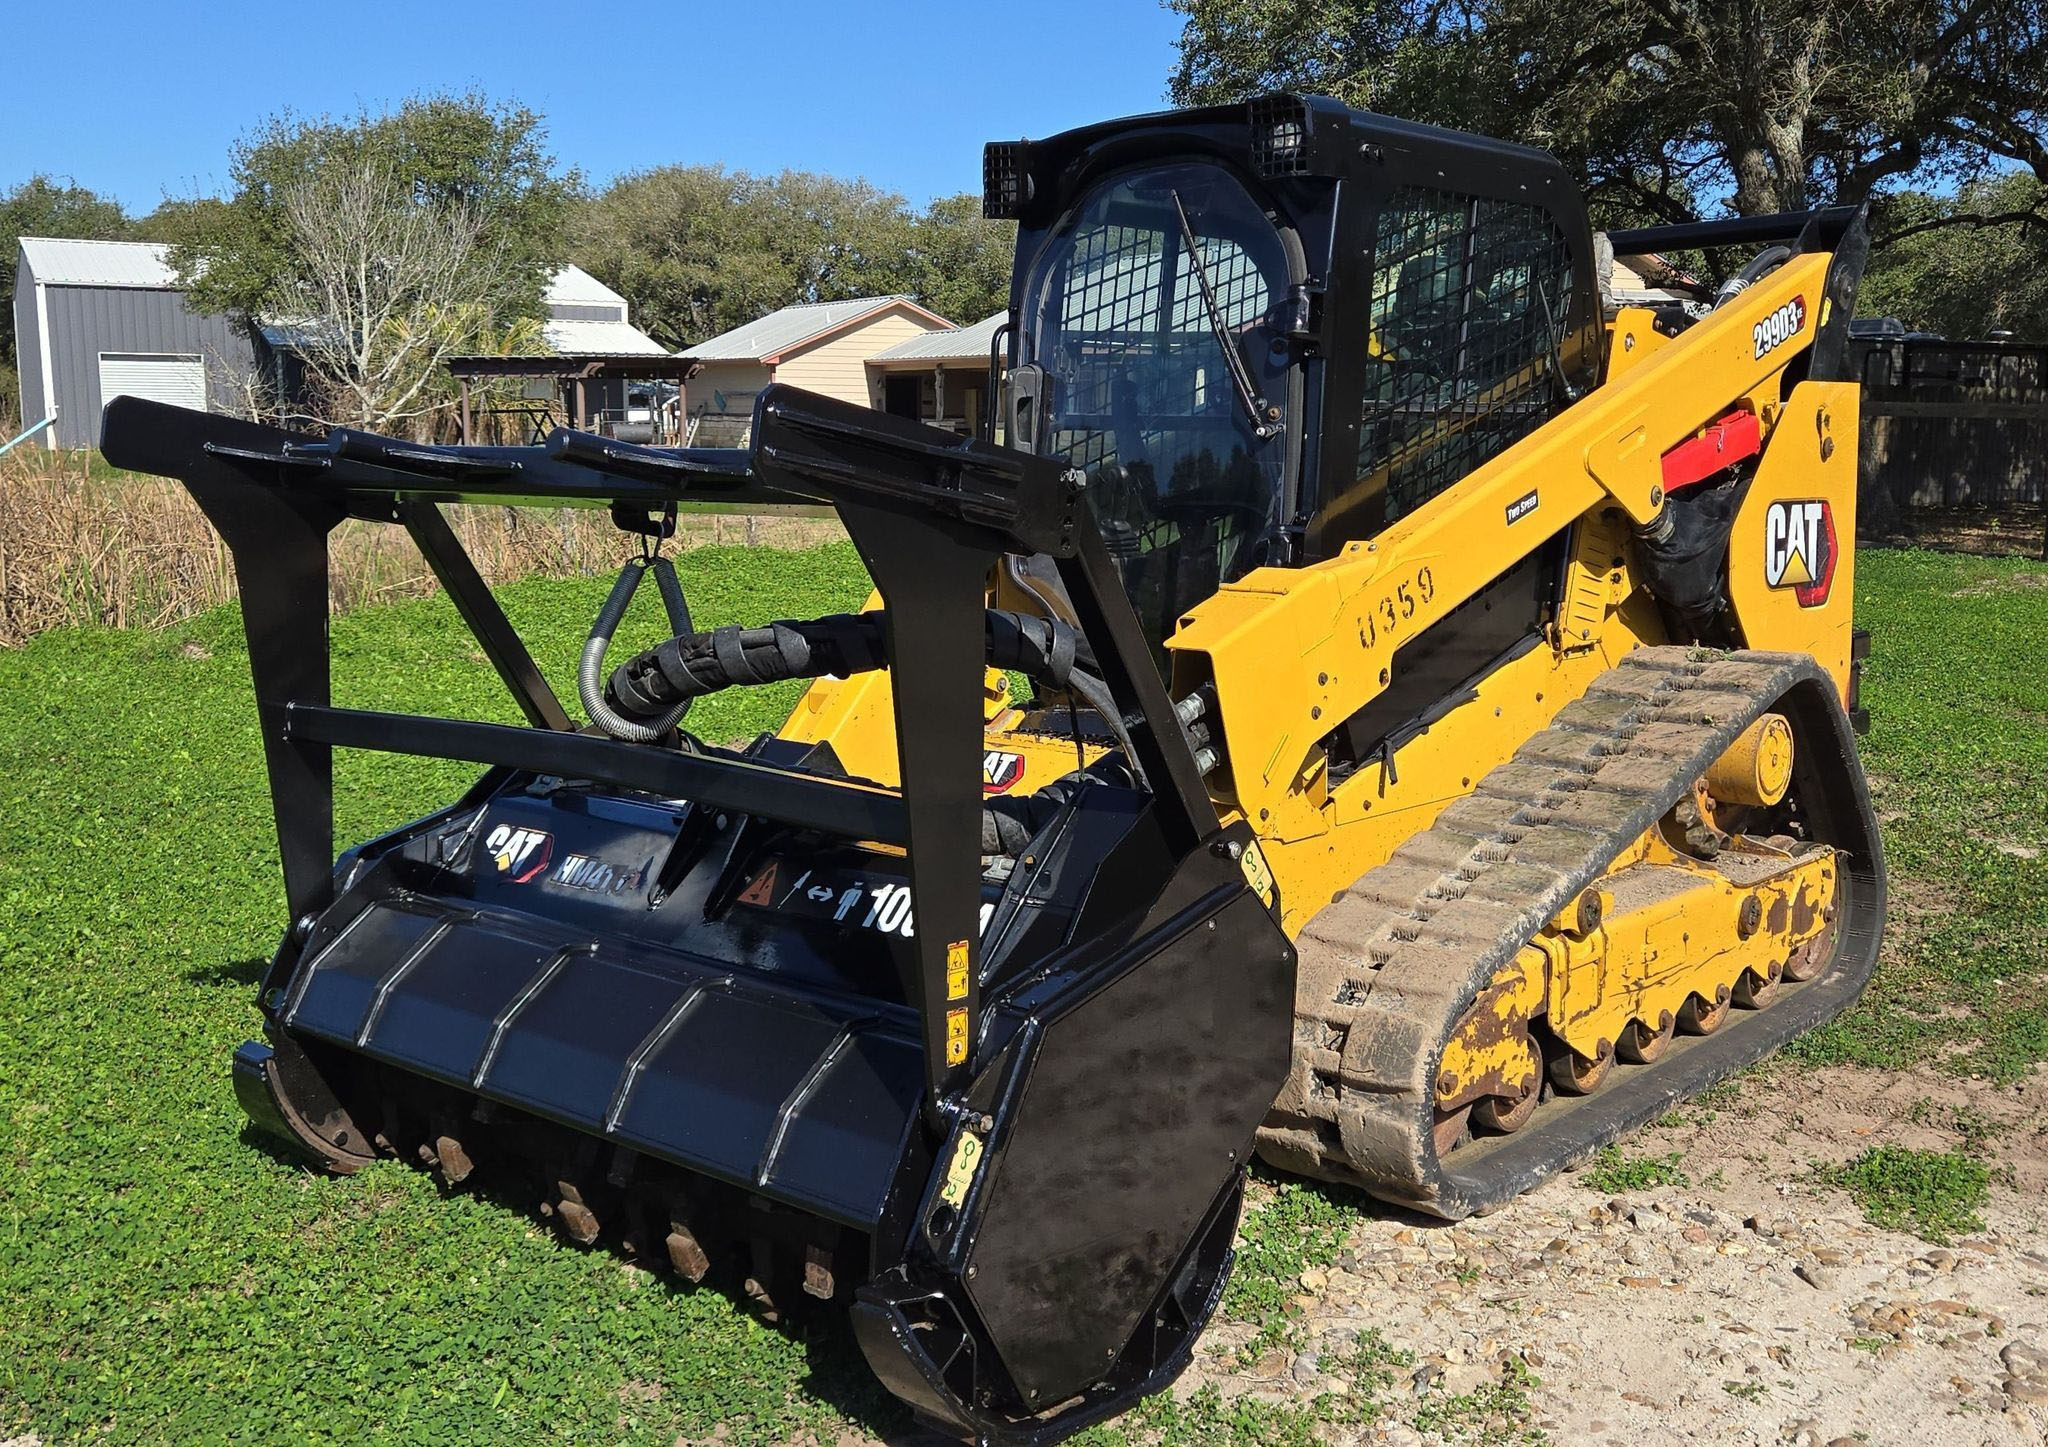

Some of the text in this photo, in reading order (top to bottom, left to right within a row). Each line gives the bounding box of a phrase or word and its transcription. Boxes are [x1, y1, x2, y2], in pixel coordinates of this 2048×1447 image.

[1753, 301, 1797, 358] 299D3
[1767, 503, 1822, 585] CAT
[983, 752, 1018, 784] AT
[486, 825, 546, 876] CAT
